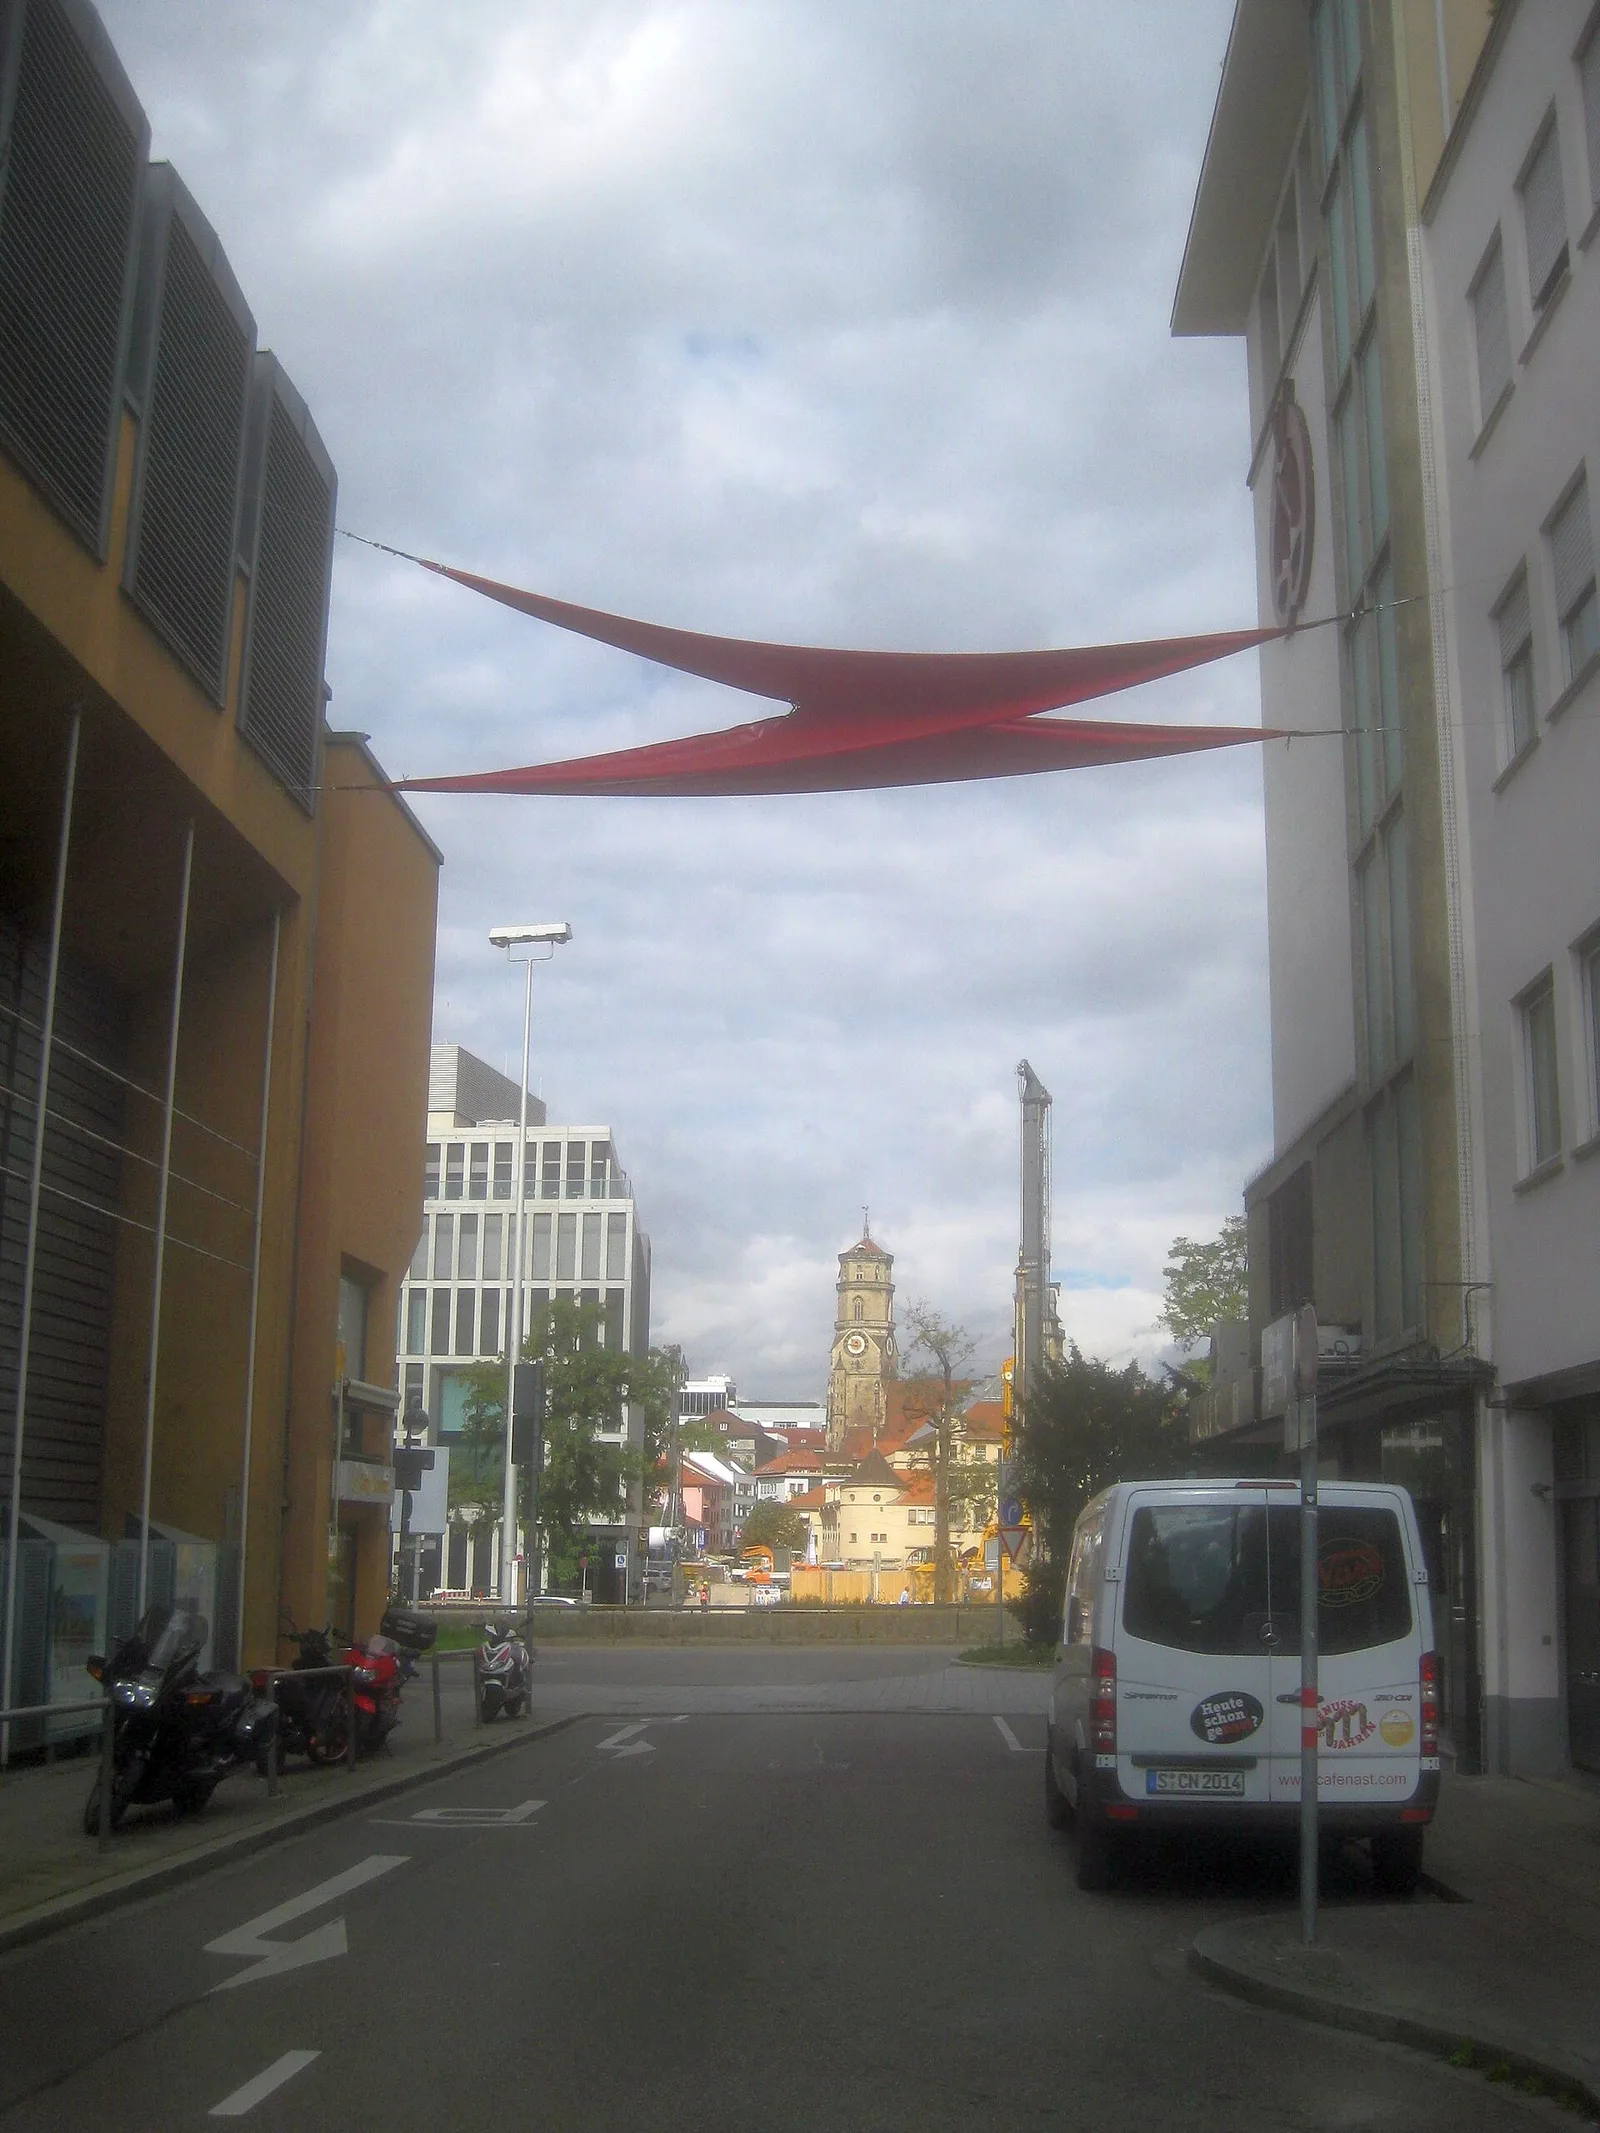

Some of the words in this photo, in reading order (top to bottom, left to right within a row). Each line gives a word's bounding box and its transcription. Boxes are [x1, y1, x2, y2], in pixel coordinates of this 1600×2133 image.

[1201, 1697, 1244, 1716] Heute
[1316, 1699, 1355, 1720] ENUSS
[1204, 1710, 1246, 1728] schon
[1333, 1720, 1376, 1749] JAHREN
[1157, 1773, 1168, 1789] S
[1178, 1774, 1198, 1789] CN
[1202, 1774, 1241, 1790] 2014
[1278, 1772, 1407, 1786] wwcafenast.com
